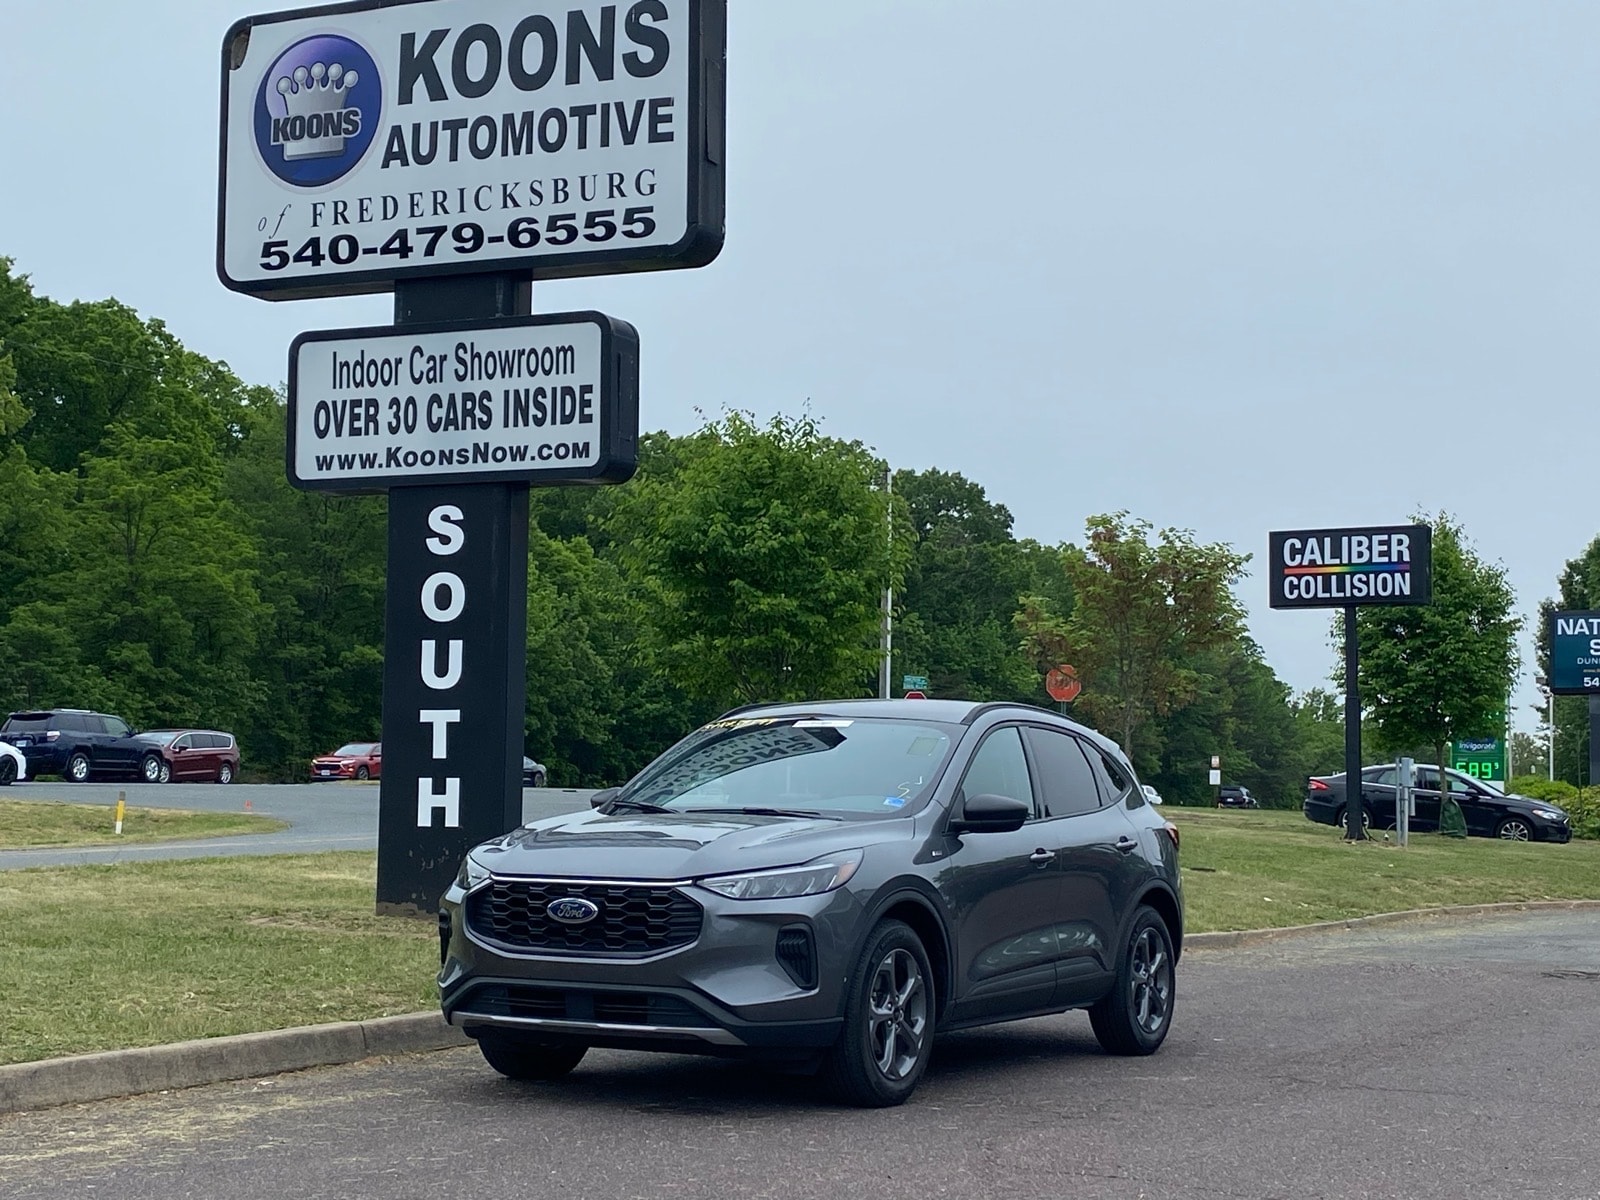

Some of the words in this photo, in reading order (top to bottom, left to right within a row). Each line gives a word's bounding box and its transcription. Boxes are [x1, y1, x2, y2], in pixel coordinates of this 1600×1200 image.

[397, 0, 670, 106] KOONS
[271, 107, 362, 145] KOONS
[381, 97, 675, 169] AUTOMOTIVE
[257, 204, 291, 240] of
[310, 168, 657, 228] FREDERICKSBURG
[259, 206, 656, 271] 540-479-6555
[332, 349, 403, 390] Indoor
[409, 345, 448, 385] Car
[454, 342, 575, 382] Showroom
[314, 397, 380, 439] OVER
[387, 395, 418, 435] 30
[426, 390, 493, 433] CARS
[503, 384, 594, 428] INSIDE
[1283, 533, 1411, 567] CALIBER
[1283, 572, 1411, 600] COLLISION
[417, 504, 465, 827] SOUTH
[557, 903, 585, 918] Ford
